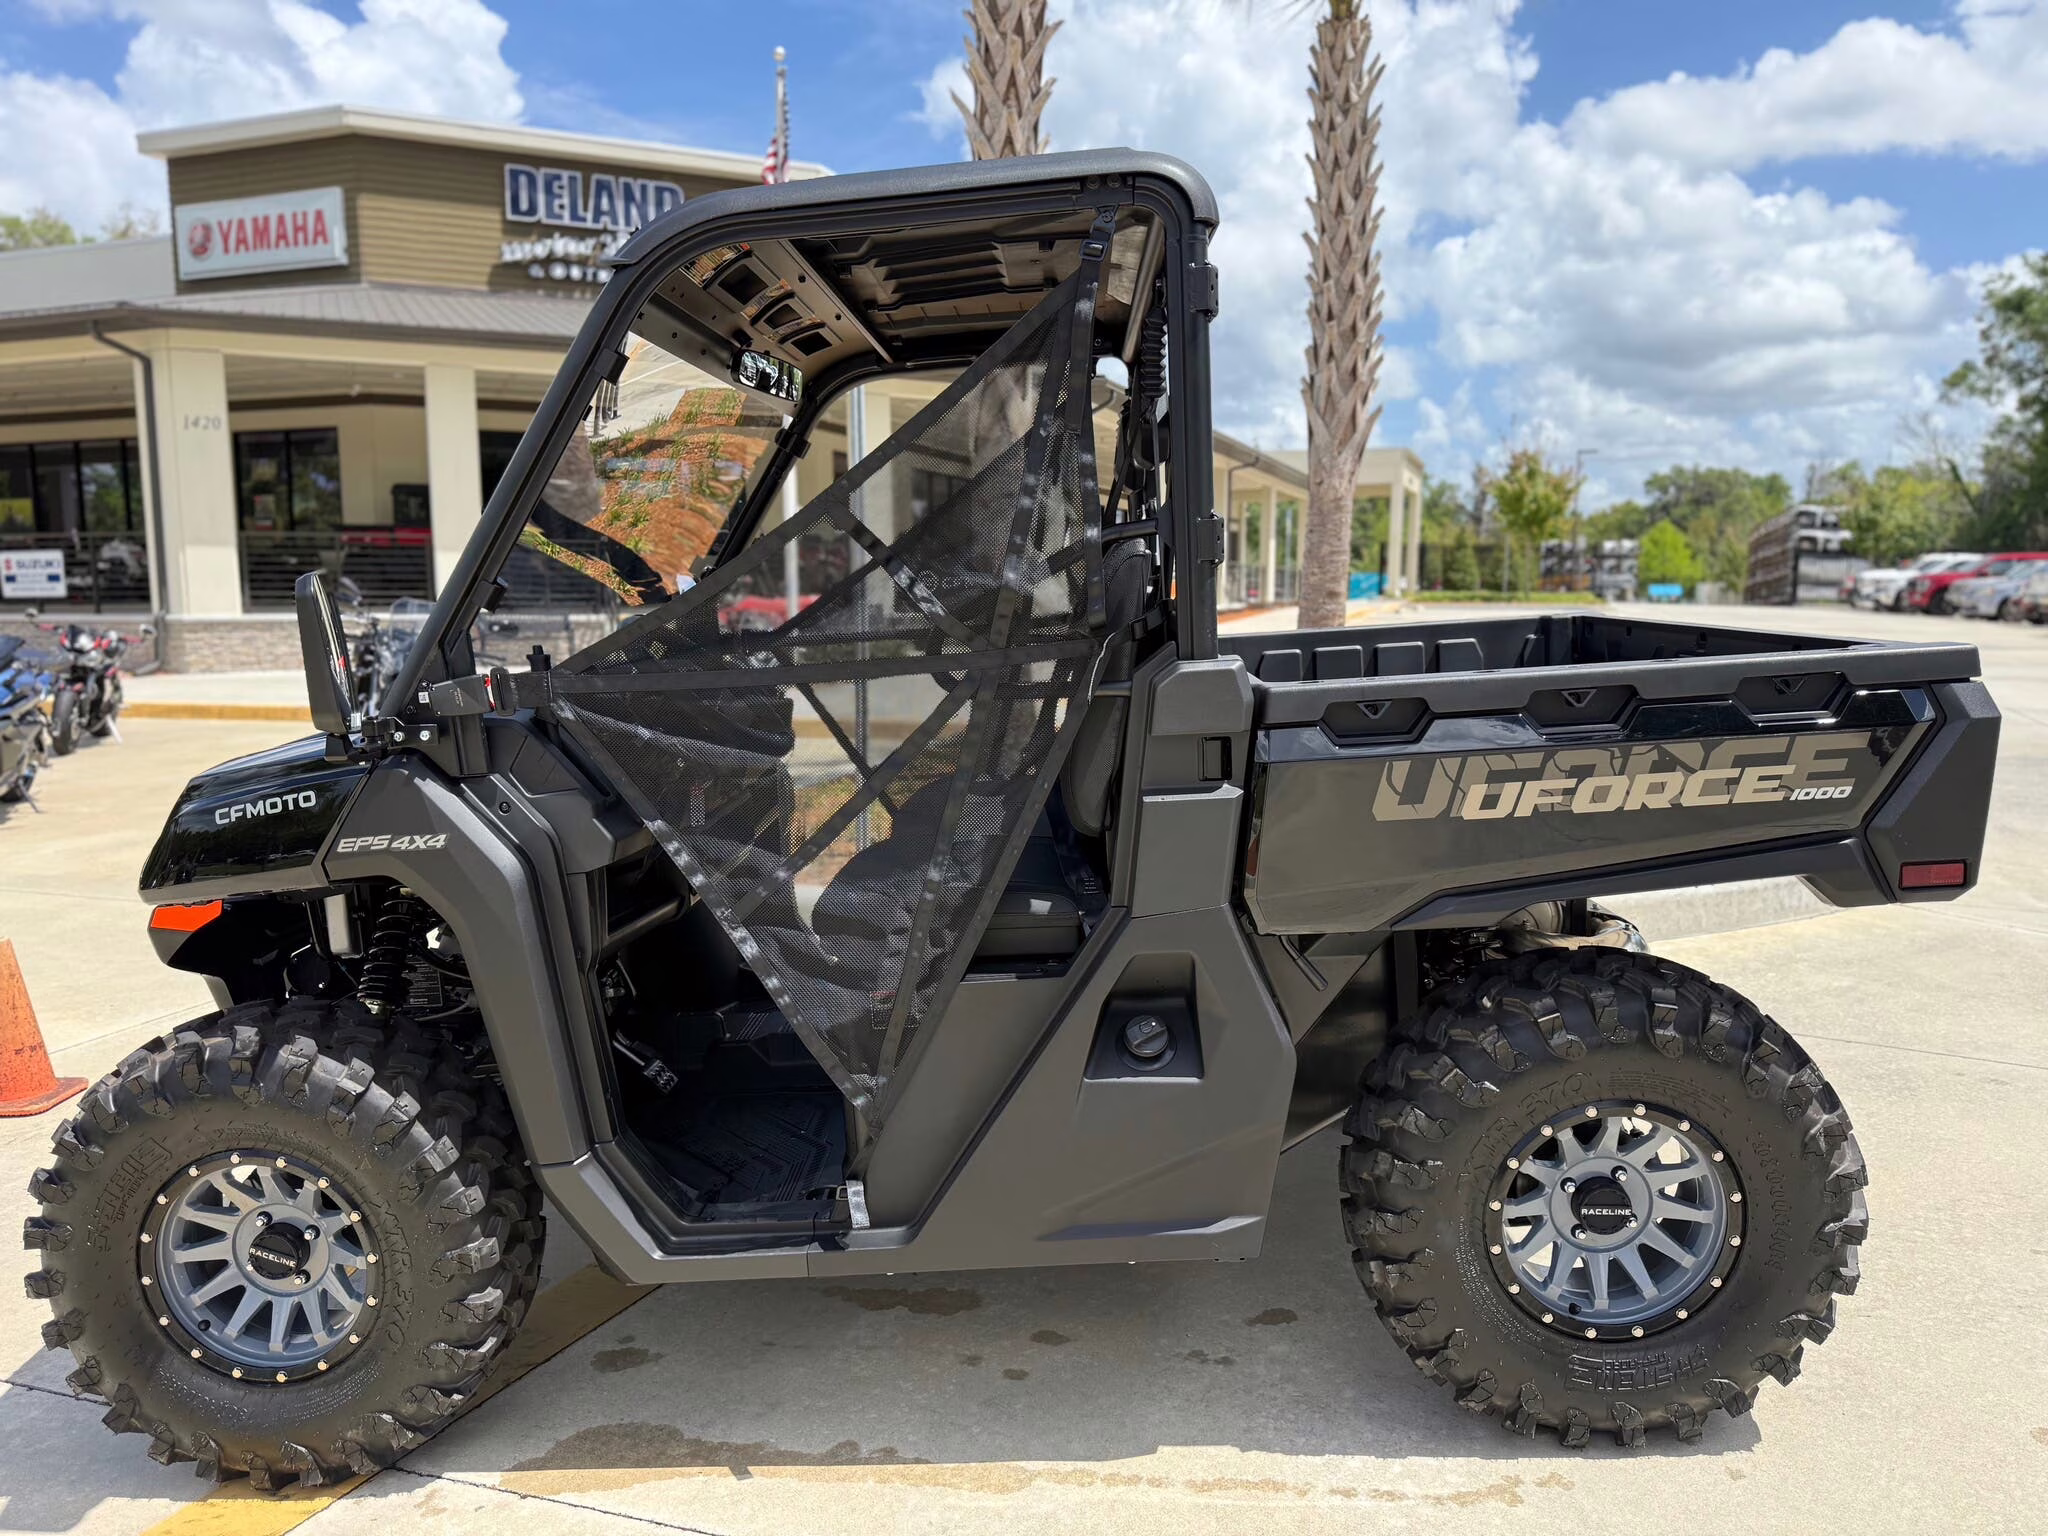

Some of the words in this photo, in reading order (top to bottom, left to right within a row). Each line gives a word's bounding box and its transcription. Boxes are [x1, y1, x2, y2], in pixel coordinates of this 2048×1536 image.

[504, 163, 685, 231] DELAND
[217, 208, 330, 256] YAMAHA
[183, 413, 222, 431] 1420
[1460, 764, 1796, 821] UFORCE
[1790, 785, 1854, 801] 1000
[214, 789, 317, 825] CFMOTO
[336, 834, 392, 853] EPS
[391, 833, 448, 851] 4X4
[1581, 1208, 1632, 1216] RACELINE
[249, 1247, 297, 1268] RACELINE
